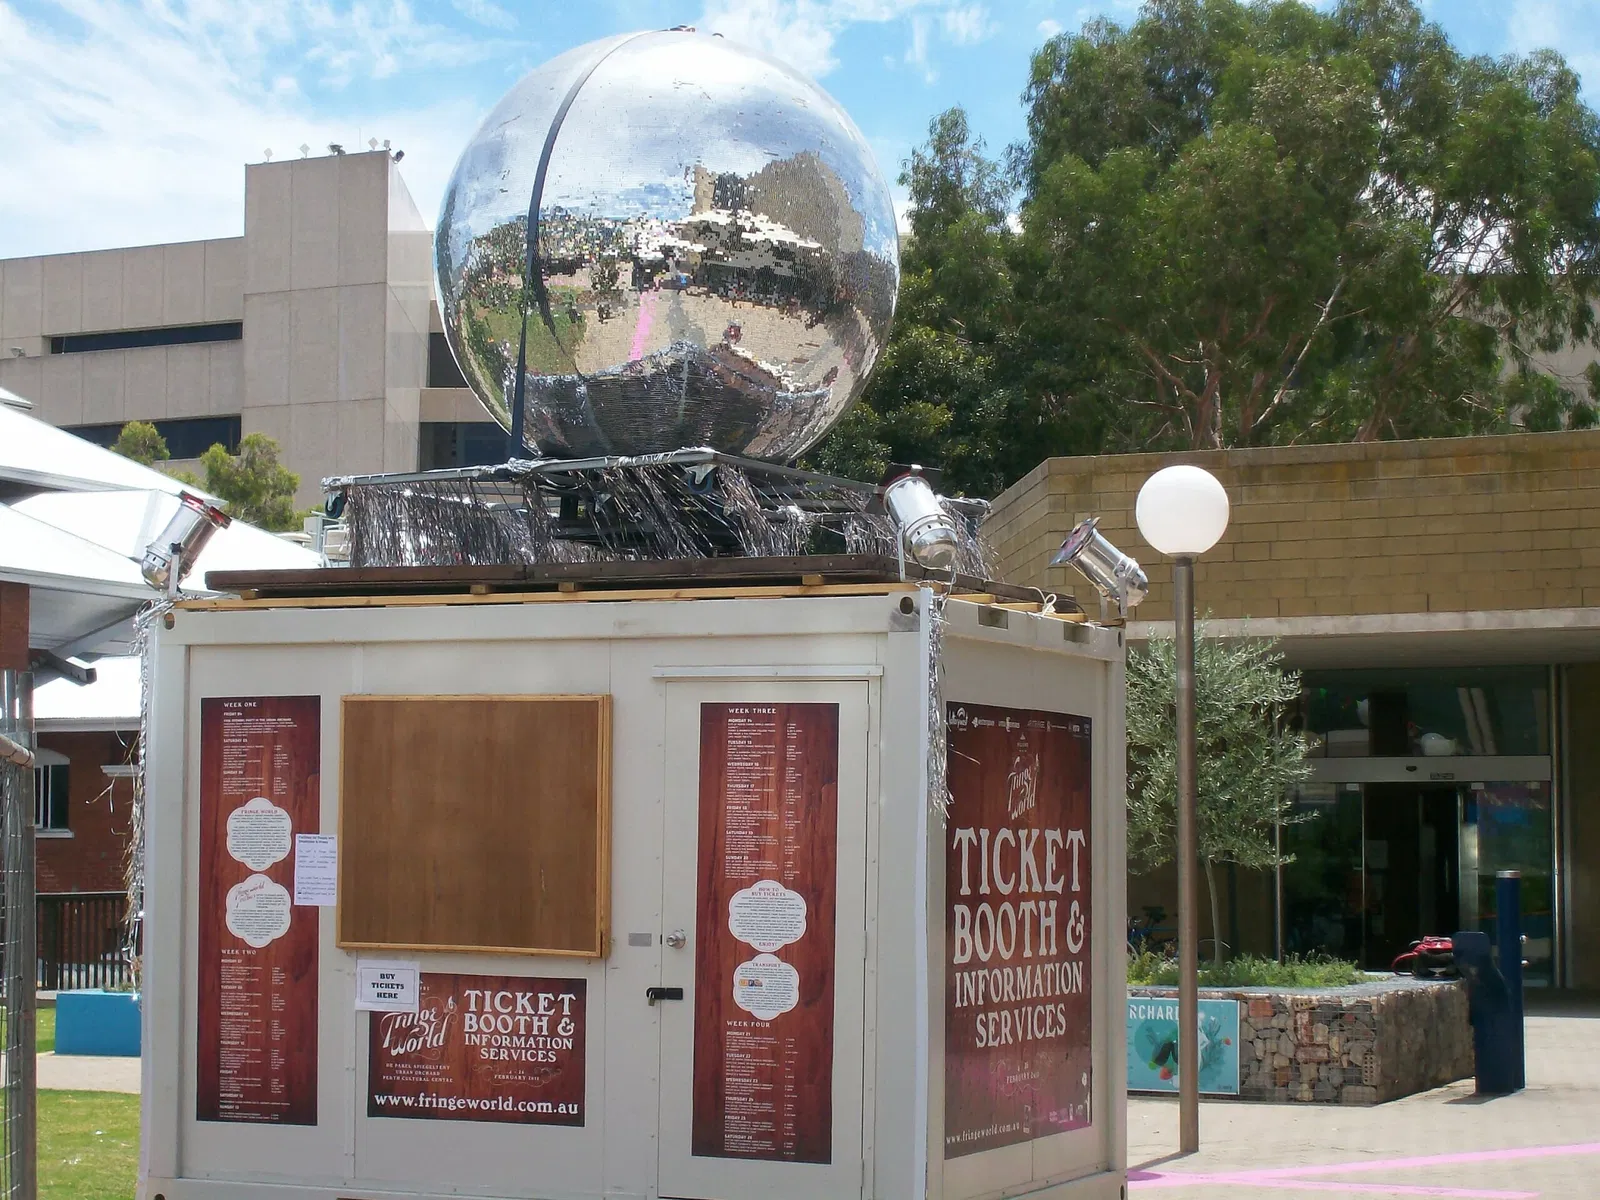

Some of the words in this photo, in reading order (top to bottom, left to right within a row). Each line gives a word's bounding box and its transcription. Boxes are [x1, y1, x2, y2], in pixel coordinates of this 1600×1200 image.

[953, 827, 1085, 895] TICKET
[954, 900, 1057, 964] BOOTH
[1066, 900, 1084, 954] &
[955, 961, 1083, 1008] INFORMATION
[464, 990, 576, 1015] TICKET
[391, 1013, 450, 1056] World
[464, 1013, 548, 1035] BOOTH
[557, 1017, 575, 1036] &
[976, 1003, 1066, 1048] SERVICES
[465, 1034, 573, 1050] INFORMATION
[480, 1048, 556, 1062] SERVICES
[374, 1092, 578, 1114] www.fringeworld.com.au
[946, 1122, 1020, 1144] www.fringeworld.com.au
